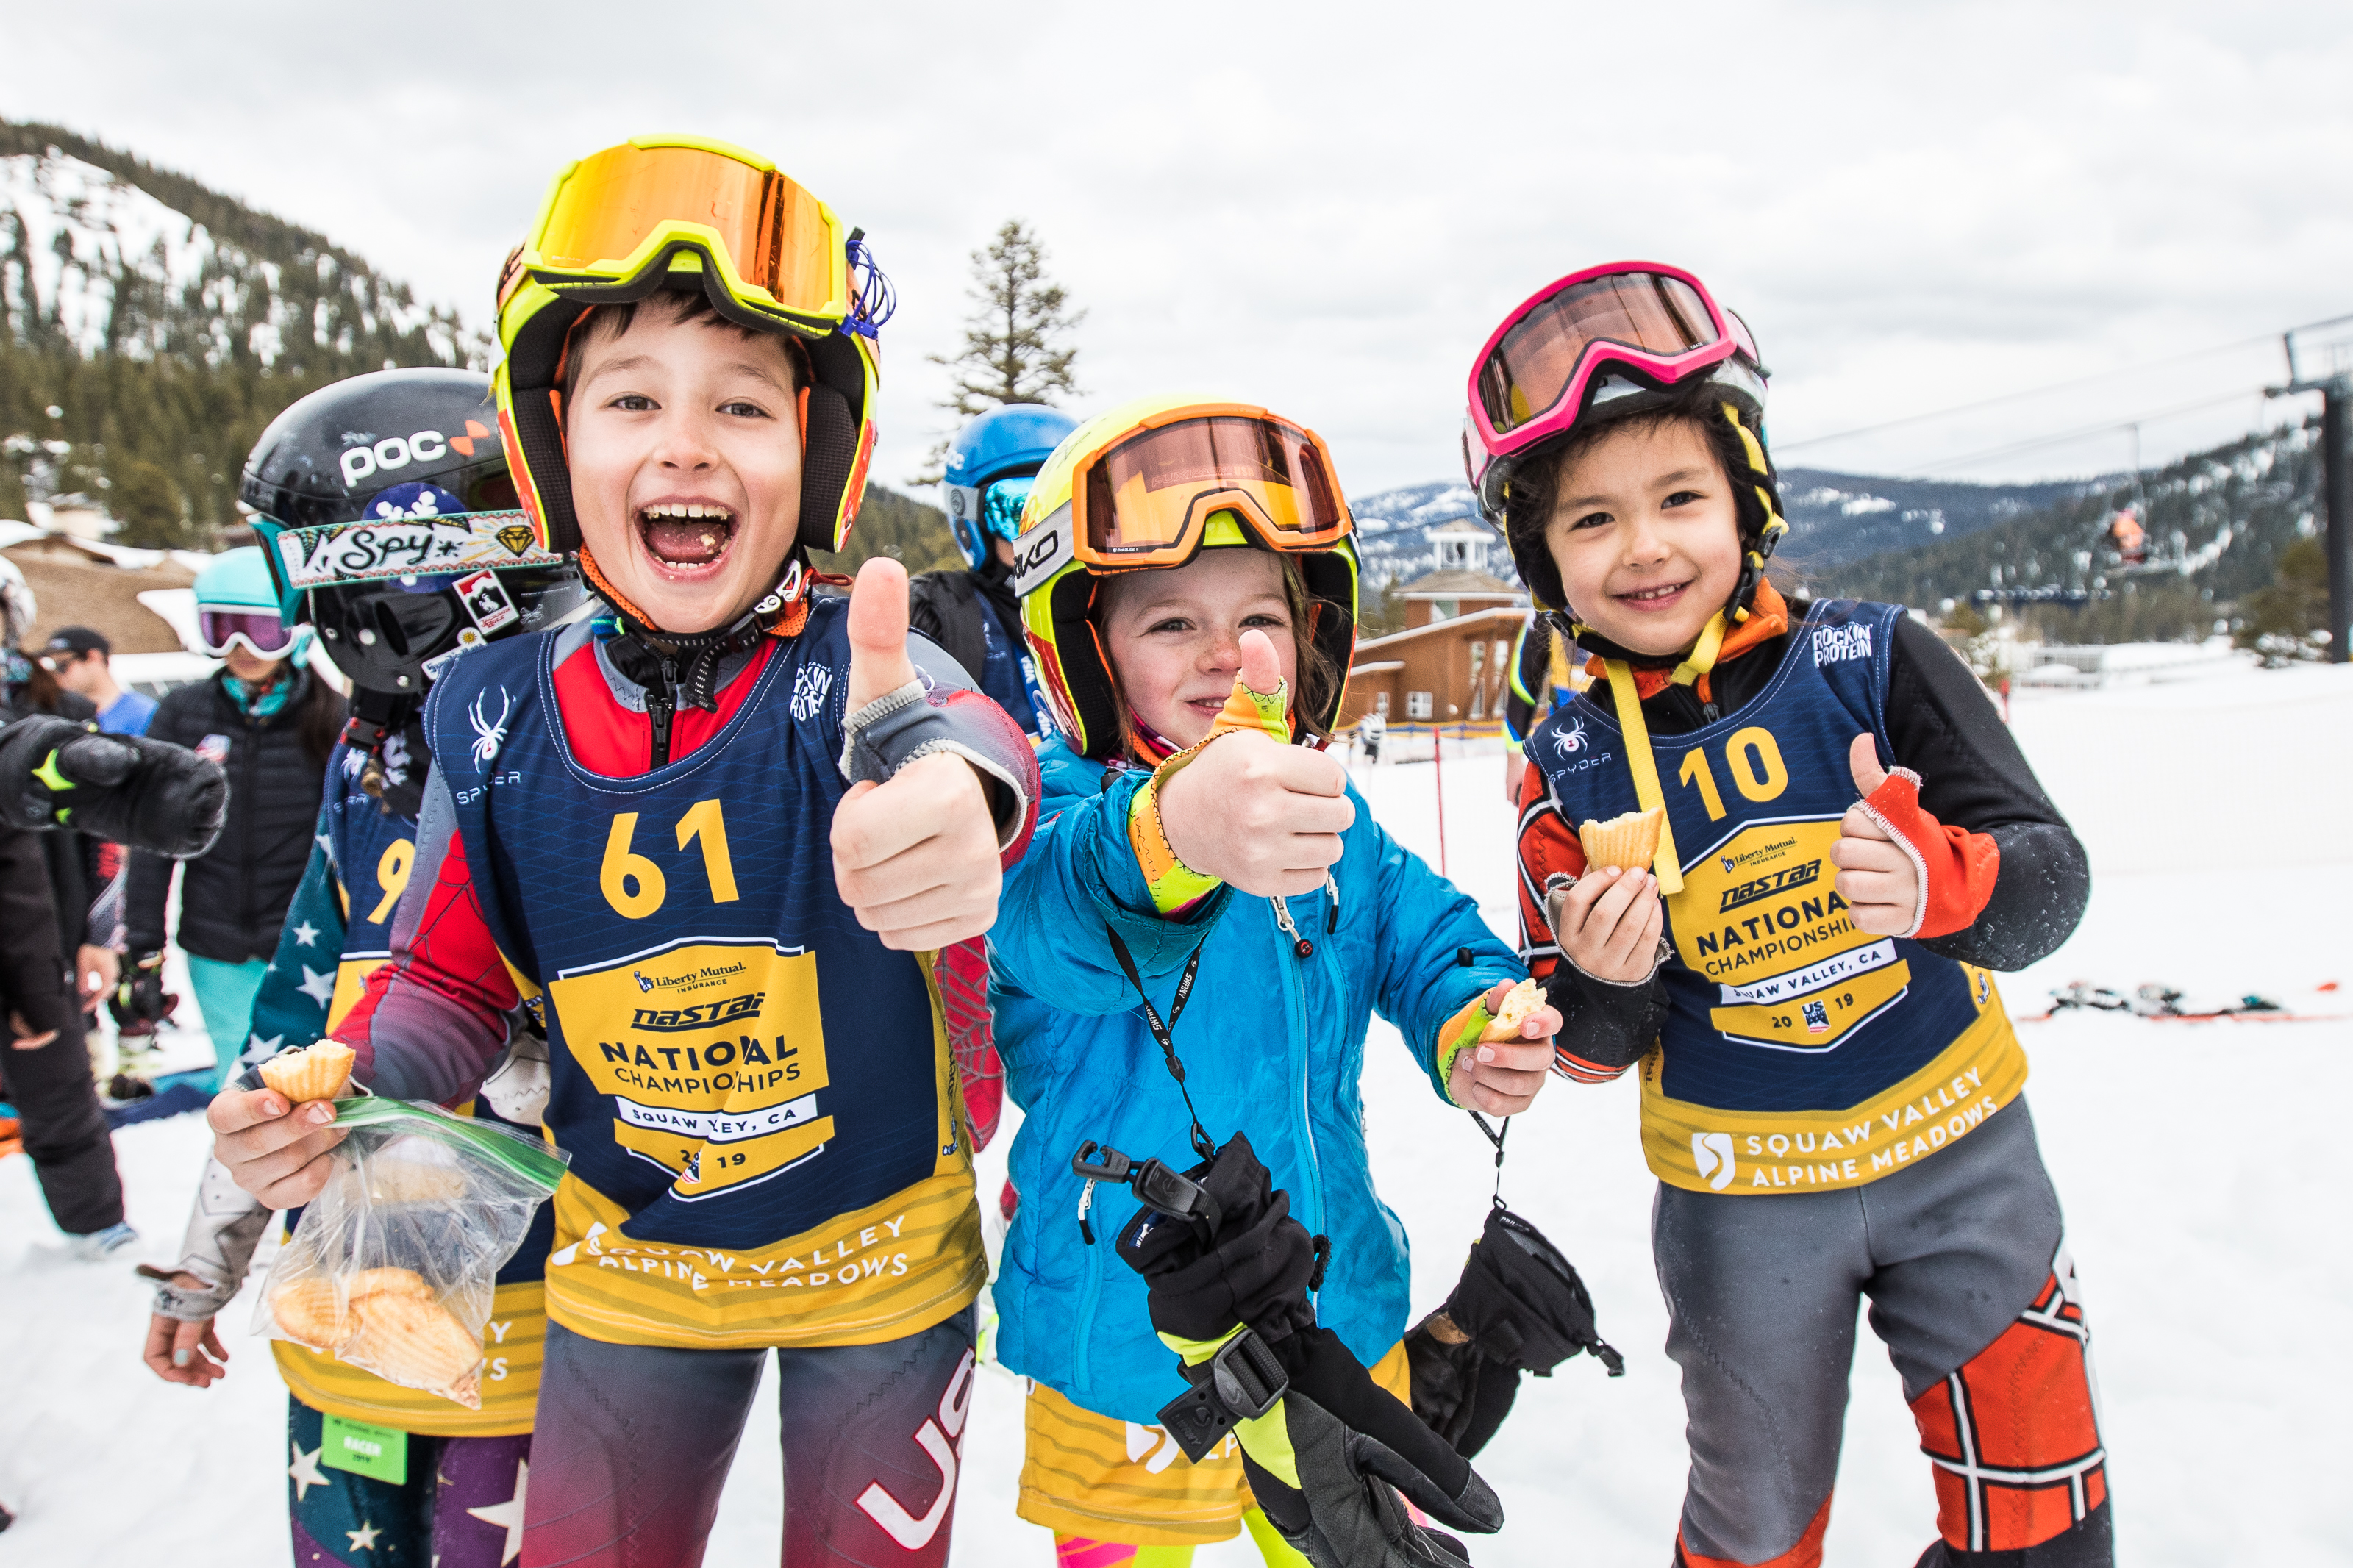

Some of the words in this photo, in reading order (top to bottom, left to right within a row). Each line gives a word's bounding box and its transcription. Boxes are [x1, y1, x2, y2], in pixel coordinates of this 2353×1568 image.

[1233, 466, 1254, 476] USA
[1813, 638, 1872, 667] PROTEIN
[1549, 752, 1612, 784] SPYDER
[1679, 726, 1788, 822] 10
[457, 771, 521, 806] SPER
[599, 798, 740, 920] 61
[1735, 849, 1763, 864] Liberty
[1750, 851, 1786, 867] INSURANCE
[1696, 890, 1849, 957] NATIONA
[1705, 917, 1857, 975] CHAMPIONSHI
[655, 973, 698, 987] Liberty
[1178, 972, 1193, 998] SWANY
[1788, 961, 1852, 989] VALLEY,
[1858, 951, 1882, 964] CA
[677, 978, 727, 994] INSURANCE
[1145, 1004, 1163, 1031] SWANY
[1772, 1015, 1793, 1028] 20
[1835, 992, 1854, 1010] 19
[1802, 1000, 1824, 1015] US
[614, 1063, 801, 1094] CHAMPIOHIPS
[632, 1109, 697, 1130] SQUAW
[768, 1109, 796, 1125] CA
[1747, 1121, 1872, 1159] SQUAW
[1881, 1066, 1984, 1131] VALLEY
[1752, 1159, 1860, 1188] ALPINE
[1871, 1096, 1999, 1172] MEADOWS
[717, 1152, 746, 1170] 19
[749, 1214, 905, 1275] VALLEY
[599, 1256, 710, 1291] ALPINE
[728, 1253, 908, 1287] MEADOWS
